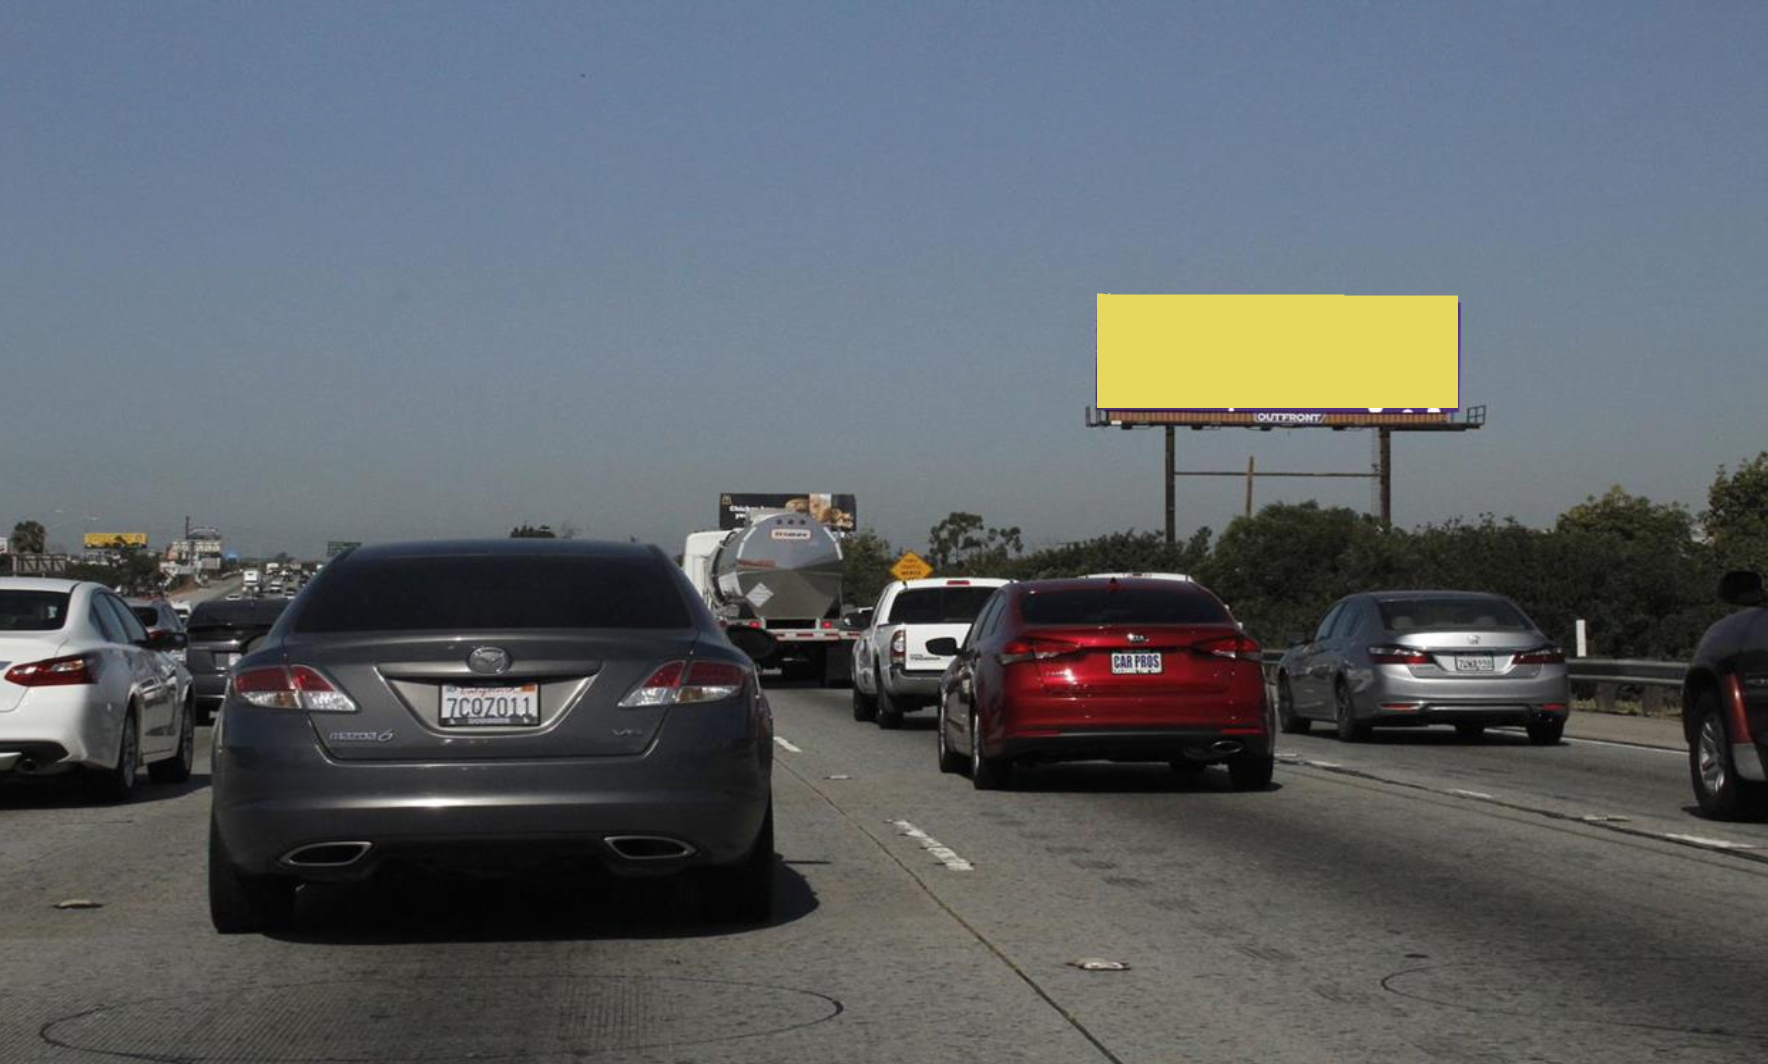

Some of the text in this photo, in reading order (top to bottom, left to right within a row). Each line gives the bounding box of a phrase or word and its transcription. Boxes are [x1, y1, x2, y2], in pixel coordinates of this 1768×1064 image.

[1257, 413, 1321, 422] OUTFRONT
[1114, 655, 1160, 669] CAR PROS
